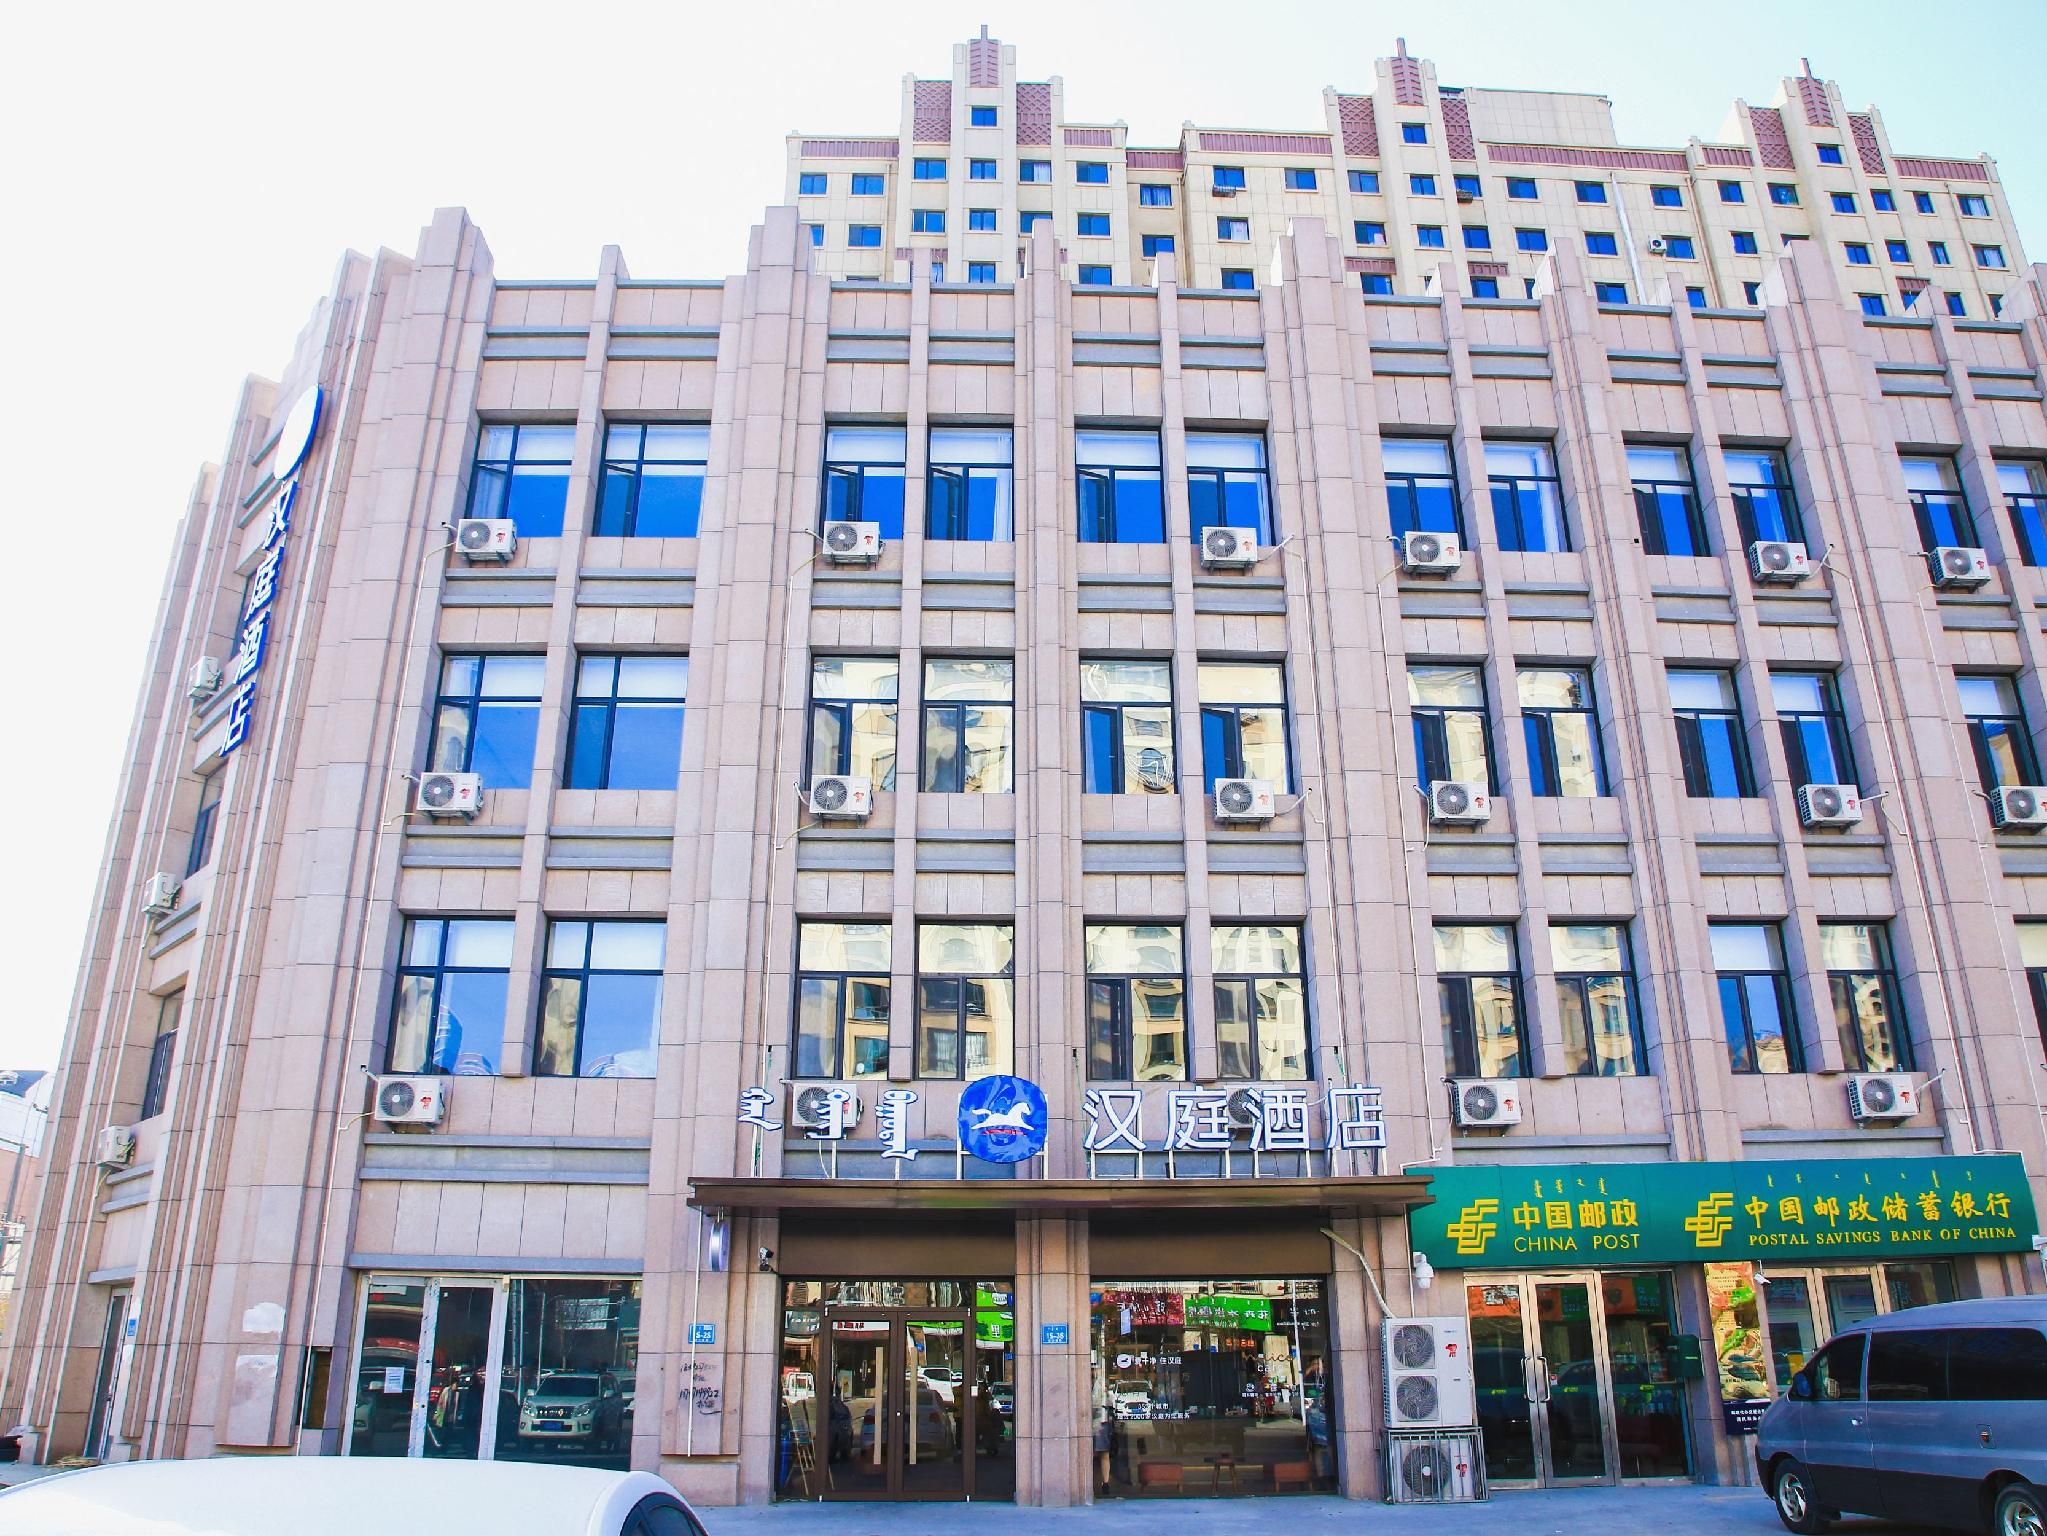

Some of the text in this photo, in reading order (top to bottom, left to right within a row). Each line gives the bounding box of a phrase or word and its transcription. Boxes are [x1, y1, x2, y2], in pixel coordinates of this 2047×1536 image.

[220, 478, 299, 757] 汉庭酒店
[1082, 1087, 1387, 1152] 汉庭酒店
[1513, 1199, 1640, 1233] 中国邮政
[1744, 1190, 2013, 1229] 中国邮政储蓄银行
[1513, 1233, 1640, 1254] CHINA POST
[1748, 1226, 2017, 1247] POSTAL SAVINGS BANK OF CHINA
